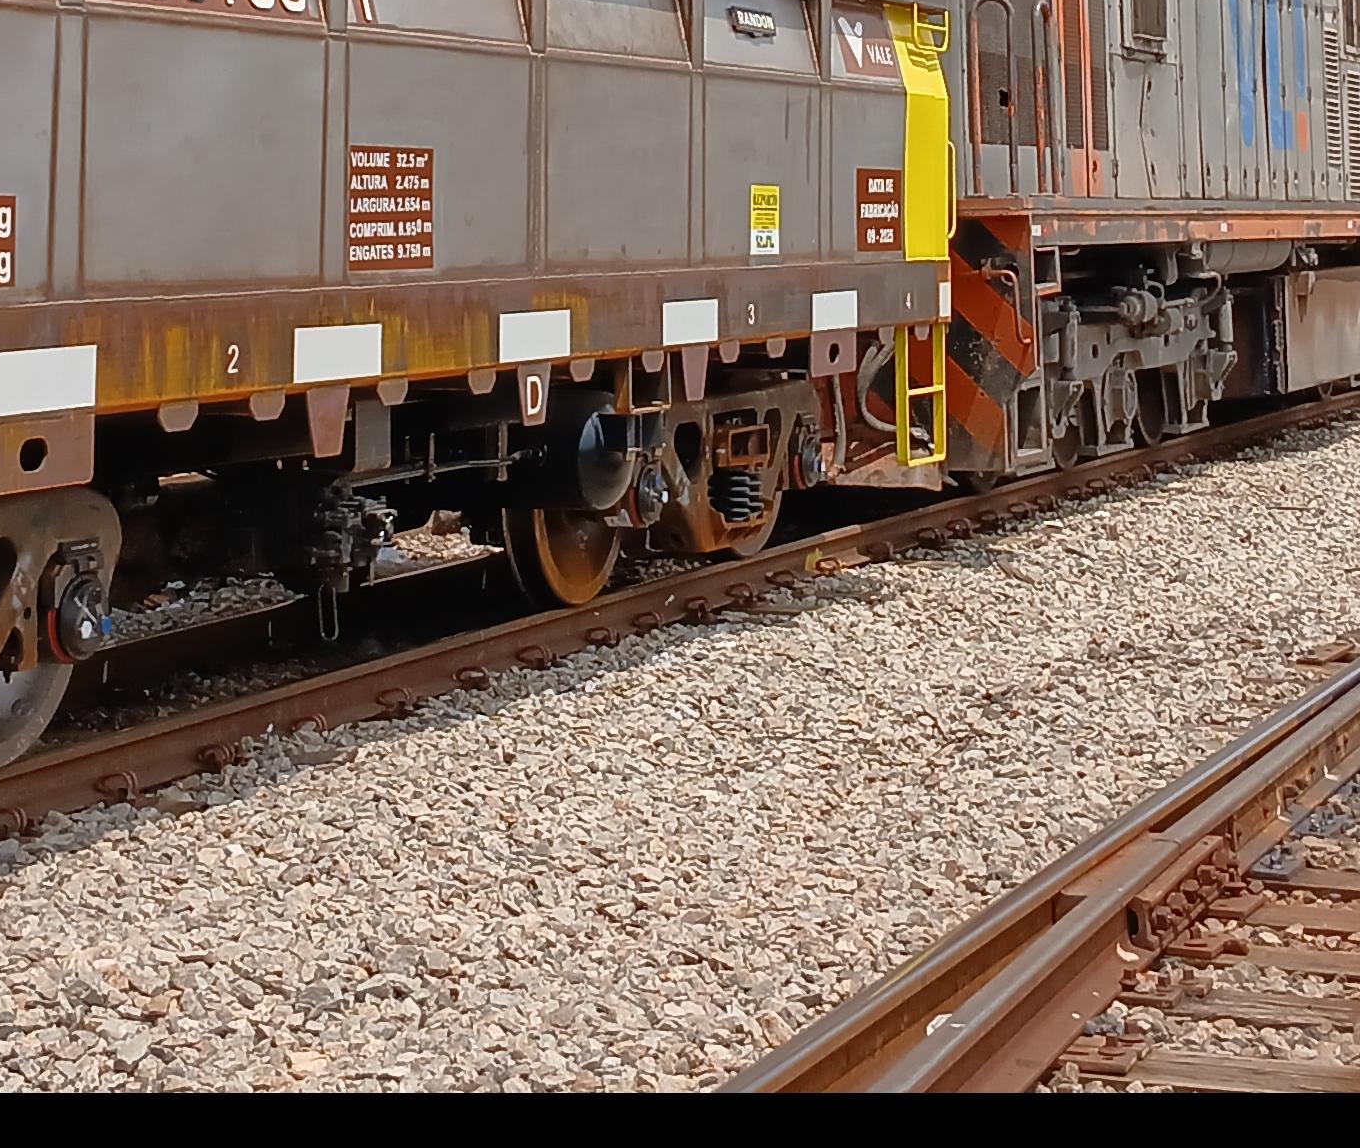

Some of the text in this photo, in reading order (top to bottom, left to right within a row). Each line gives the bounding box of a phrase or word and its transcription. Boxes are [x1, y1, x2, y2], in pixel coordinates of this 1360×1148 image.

[736, 10, 775, 30] RANDON
[866, 43, 894, 66] VALE
[350, 152, 391, 168] VOLUME
[396, 153, 415, 168] 32.5
[350, 175, 430, 190] ALTURA 2.475 m
[868, 178, 884, 193] DATA
[350, 197, 431, 213] LARGURA 2.654 m
[349, 221, 397, 238] COMPRIM.
[423, 222, 432, 233] m
[349, 244, 394, 261] ENGATES
[422, 246, 431, 257] m
[747, 303, 755, 325] 3
[227, 344, 239, 374] 2
[526, 375, 543, 416] D
